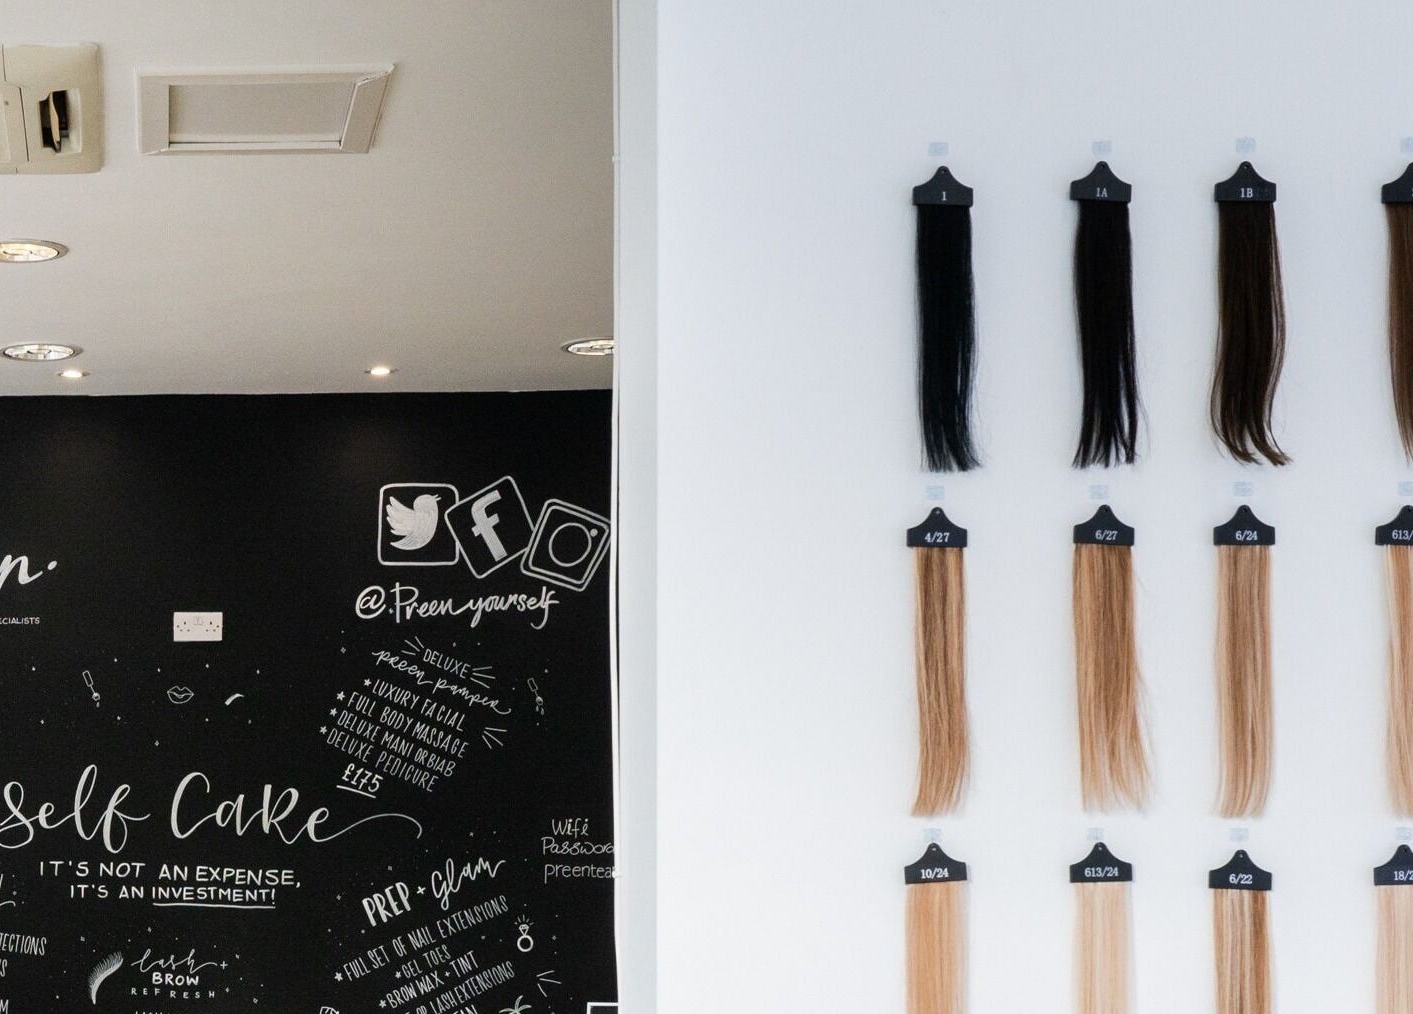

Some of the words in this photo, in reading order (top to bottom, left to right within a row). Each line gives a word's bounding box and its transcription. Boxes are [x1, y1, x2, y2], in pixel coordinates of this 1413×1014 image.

[1095, 188, 1108, 198] 1A
[1240, 188, 1253, 198] 1B
[924, 531, 950, 543] 4/27
[1095, 529, 1118, 541] 6/27
[1235, 530, 1258, 541] 6/24
[423, 648, 472, 679] DELUXE
[372, 679, 419, 710] LUXURY
[421, 698, 465, 732] FACIAL
[347, 691, 376, 718] FULL
[379, 706, 414, 733] BODY
[412, 722, 470, 759] MASSAGE
[336, 710, 380, 743] DELUXE
[380, 727, 412, 757] MANI
[414, 747, 428, 765] OR
[426, 751, 457, 777] BIAB
[326, 727, 374, 764] DELUXE
[374, 751, 439, 793] PEDICURE
[341, 763, 384, 793] £175
[39, 860, 90, 877] IT'S
[99, 862, 146, 878] NOT
[158, 864, 189, 881] AN
[195, 865, 302, 888] EXPENSE,
[920, 867, 949, 879] 10/24
[1084, 866, 1120, 878] 613/24
[1229, 873, 1253, 885] 6/22
[70, 883, 109, 899] IT'S
[118, 885, 145, 899] AN
[152, 885, 276, 903] INVESTMENT!
[361, 881, 412, 928] PREP
[430, 856, 506, 911] Glam
[343, 958, 371, 983] FULL
[368, 945, 390, 971] SET
[392, 937, 411, 958] OF
[410, 925, 437, 951] NAIL
[436, 894, 510, 940] EXTENSIONS
[131, 948, 218, 974] lash
[401, 958, 424, 980] GEL
[425, 943, 452, 969] TOES
[152, 971, 199, 986] BROW
[386, 985, 418, 1010] BROW
[417, 970, 445, 997] WAX
[449, 950, 479, 979] TINT
[454, 960, 516, 1005] EXTENSIONS
[131, 987, 215, 999] REFRESH
